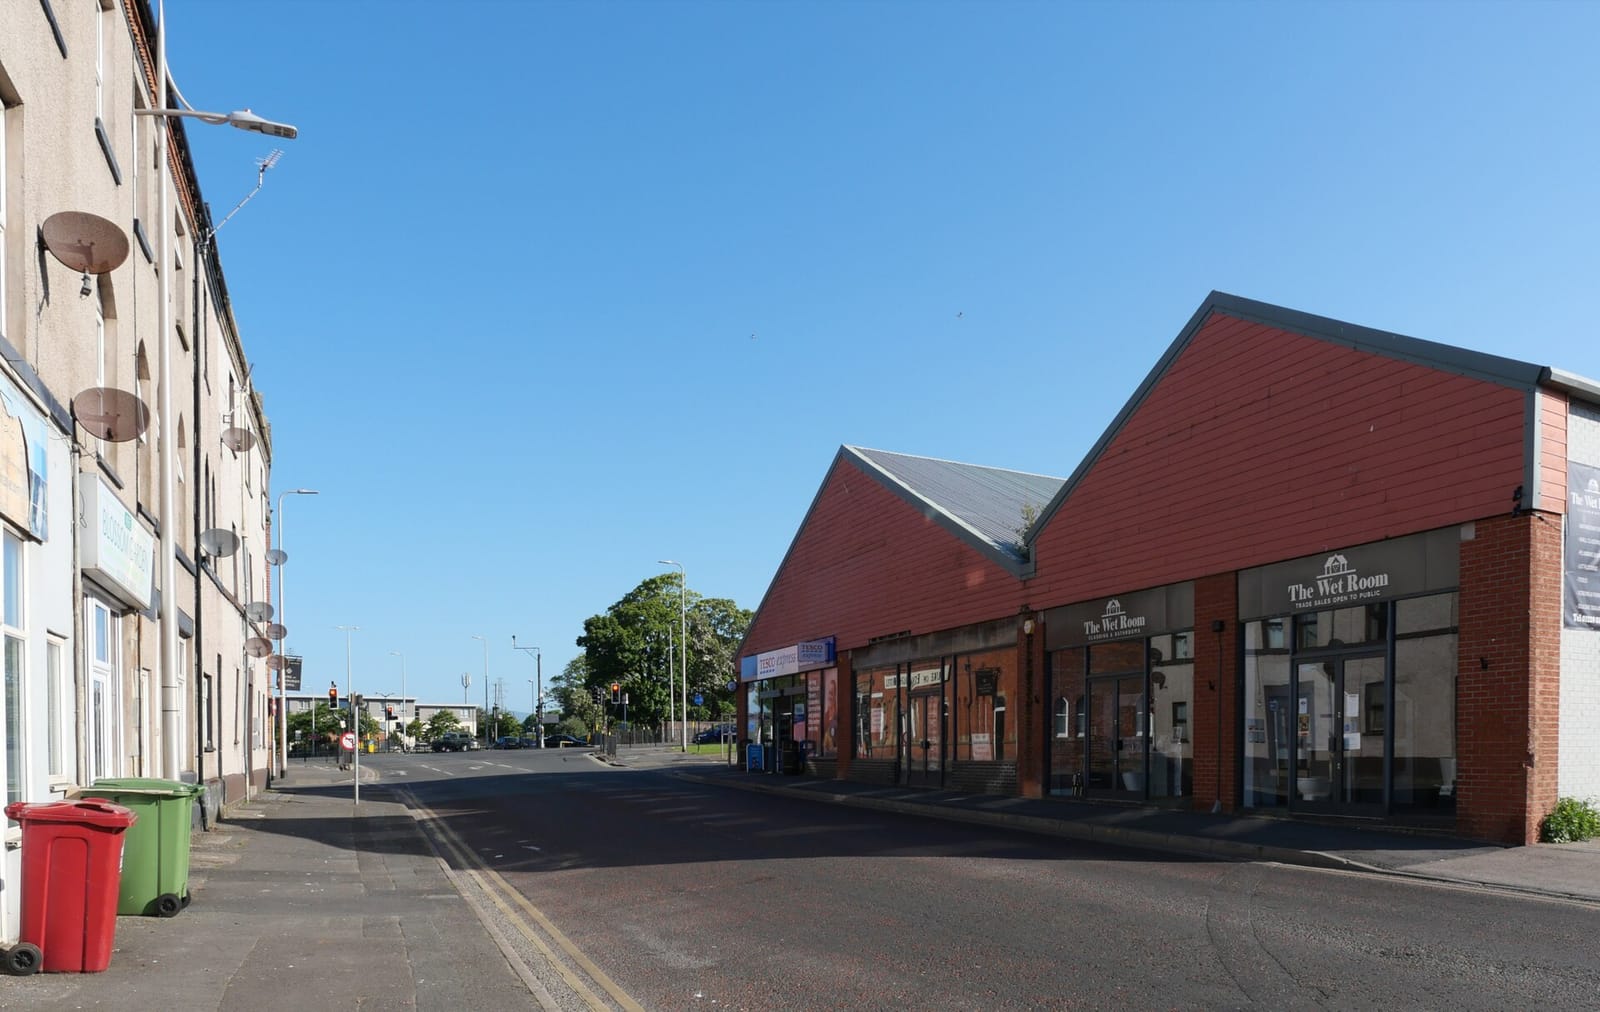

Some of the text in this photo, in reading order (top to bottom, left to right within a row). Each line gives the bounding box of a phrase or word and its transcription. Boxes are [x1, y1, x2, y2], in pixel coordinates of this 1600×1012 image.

[1570, 491, 1598, 508] The Wet
[1288, 573, 1389, 601] The Wet Room
[1296, 601, 1312, 609] TRADE
[1314, 598, 1331, 606] SALES
[1332, 595, 1348, 603] OPEN
[1359, 590, 1381, 598] PUBLIC
[1084, 615, 1145, 635] The Wet Room
[802, 643, 823, 651] TESCO
[760, 653, 796, 670] TESCO express
